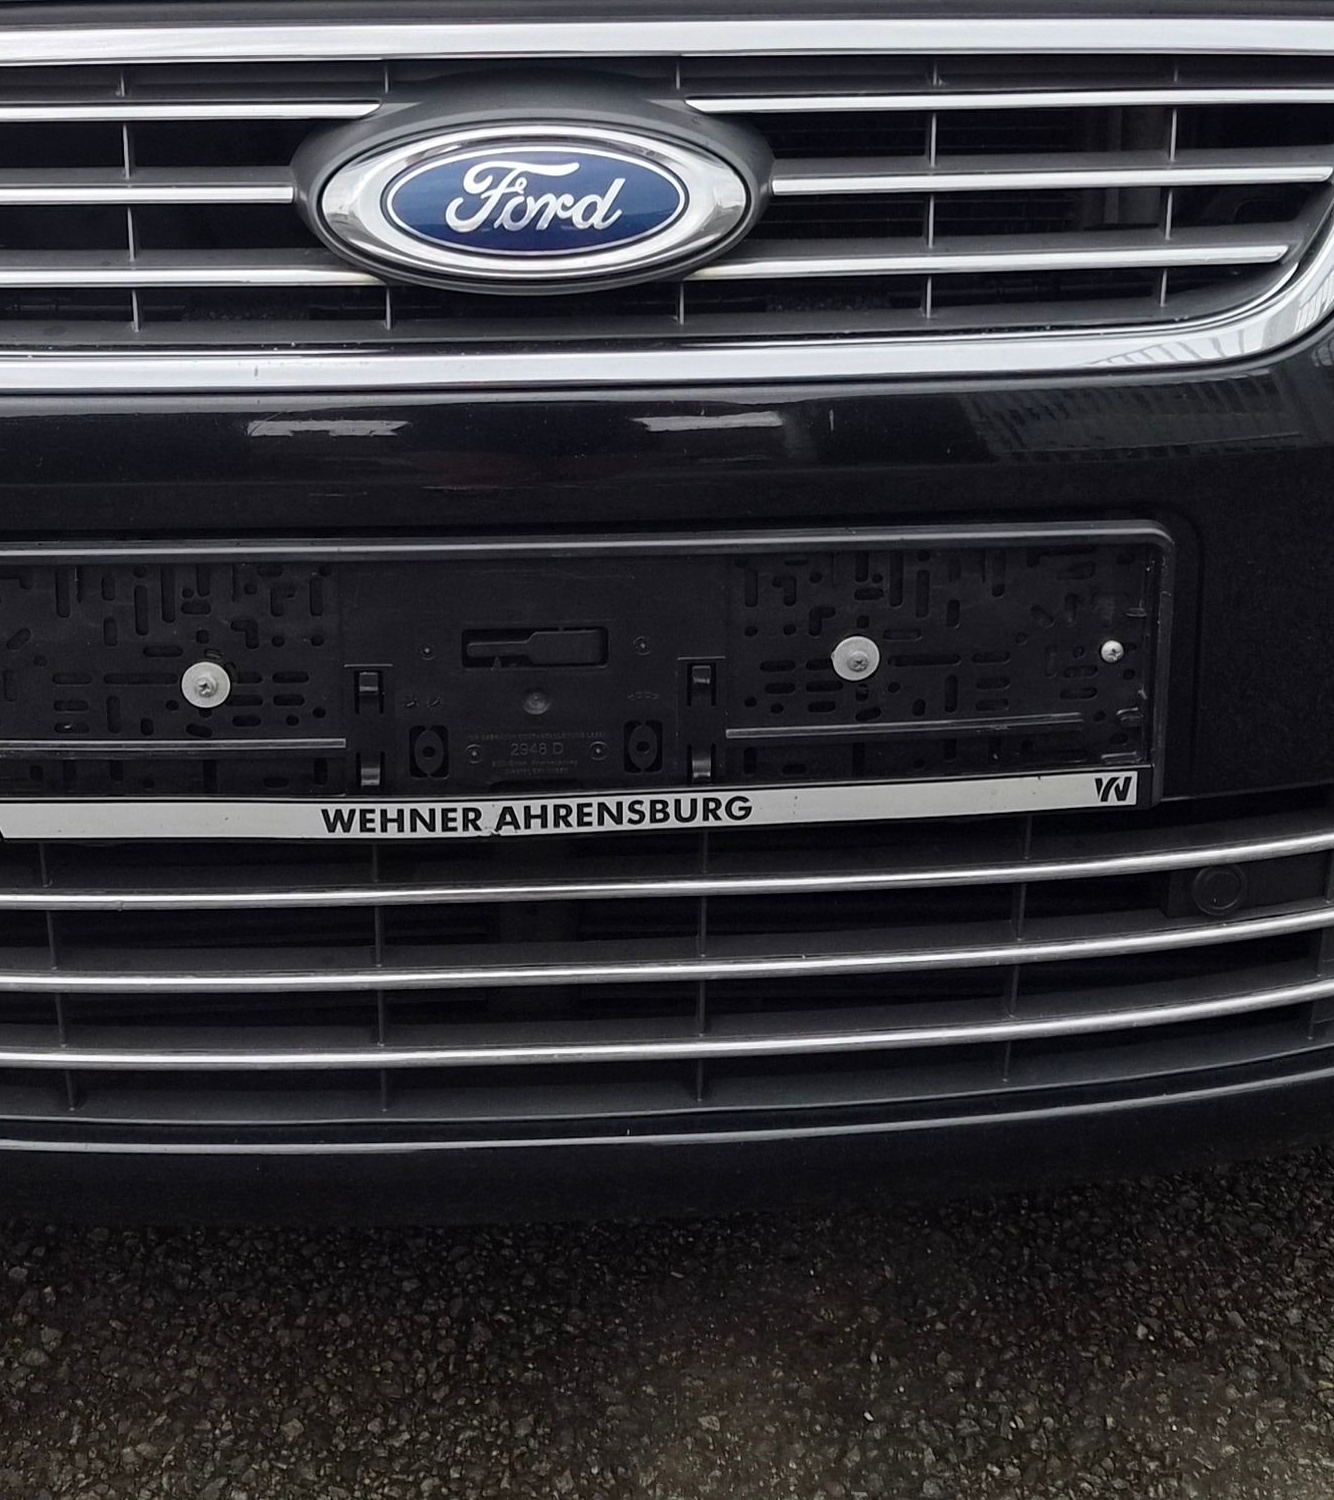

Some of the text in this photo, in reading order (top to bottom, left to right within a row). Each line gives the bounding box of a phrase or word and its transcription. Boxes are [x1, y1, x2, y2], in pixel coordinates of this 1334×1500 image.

[444, 160, 627, 233] Ford
[552, 741, 564, 755] D
[321, 796, 752, 833] WEHNER AHRENSBURG
